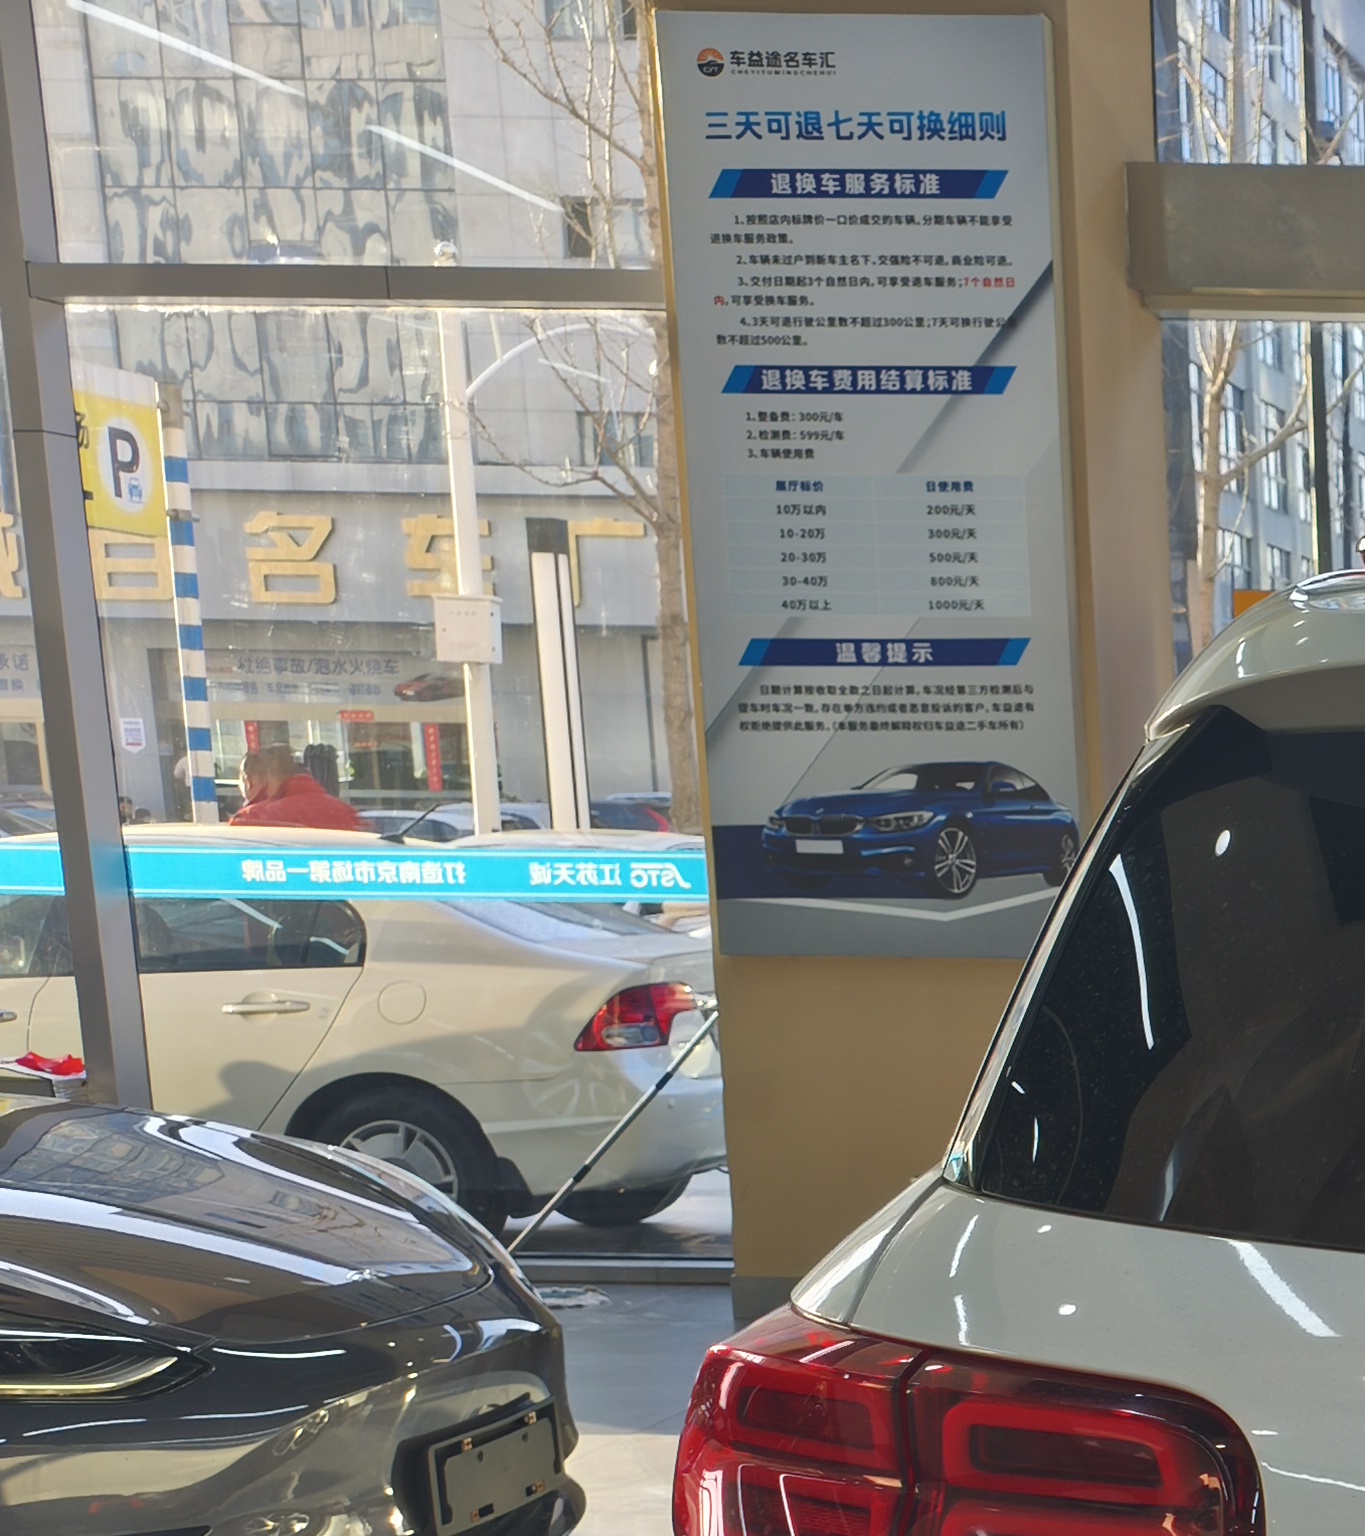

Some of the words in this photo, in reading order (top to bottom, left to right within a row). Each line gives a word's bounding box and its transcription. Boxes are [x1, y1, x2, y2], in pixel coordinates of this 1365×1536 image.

[729, 50, 836, 69] 车益途名车汇
[705, 111, 1008, 142] 三天可退七天可换细则
[770, 172, 941, 195] 退换车服务标准
[760, 368, 974, 392] 退换车费用结算标准
[107, 425, 140, 498] P
[775, 480, 824, 492] 展厅标价
[926, 480, 974, 492] 日使用费
[776, 503, 826, 516] 10万以内
[926, 503, 976, 516] 200元/天
[779, 527, 825, 540] 10-20万
[927, 527, 978, 540] 300元/天
[780, 551, 827, 564] 20-30万
[929, 551, 979, 564] 500元/天
[781, 575, 828, 588] 30-40万
[781, 599, 832, 612] 40万以上
[928, 599, 985, 612] 1000元/天
[836, 642, 934, 664] 温馨提示
